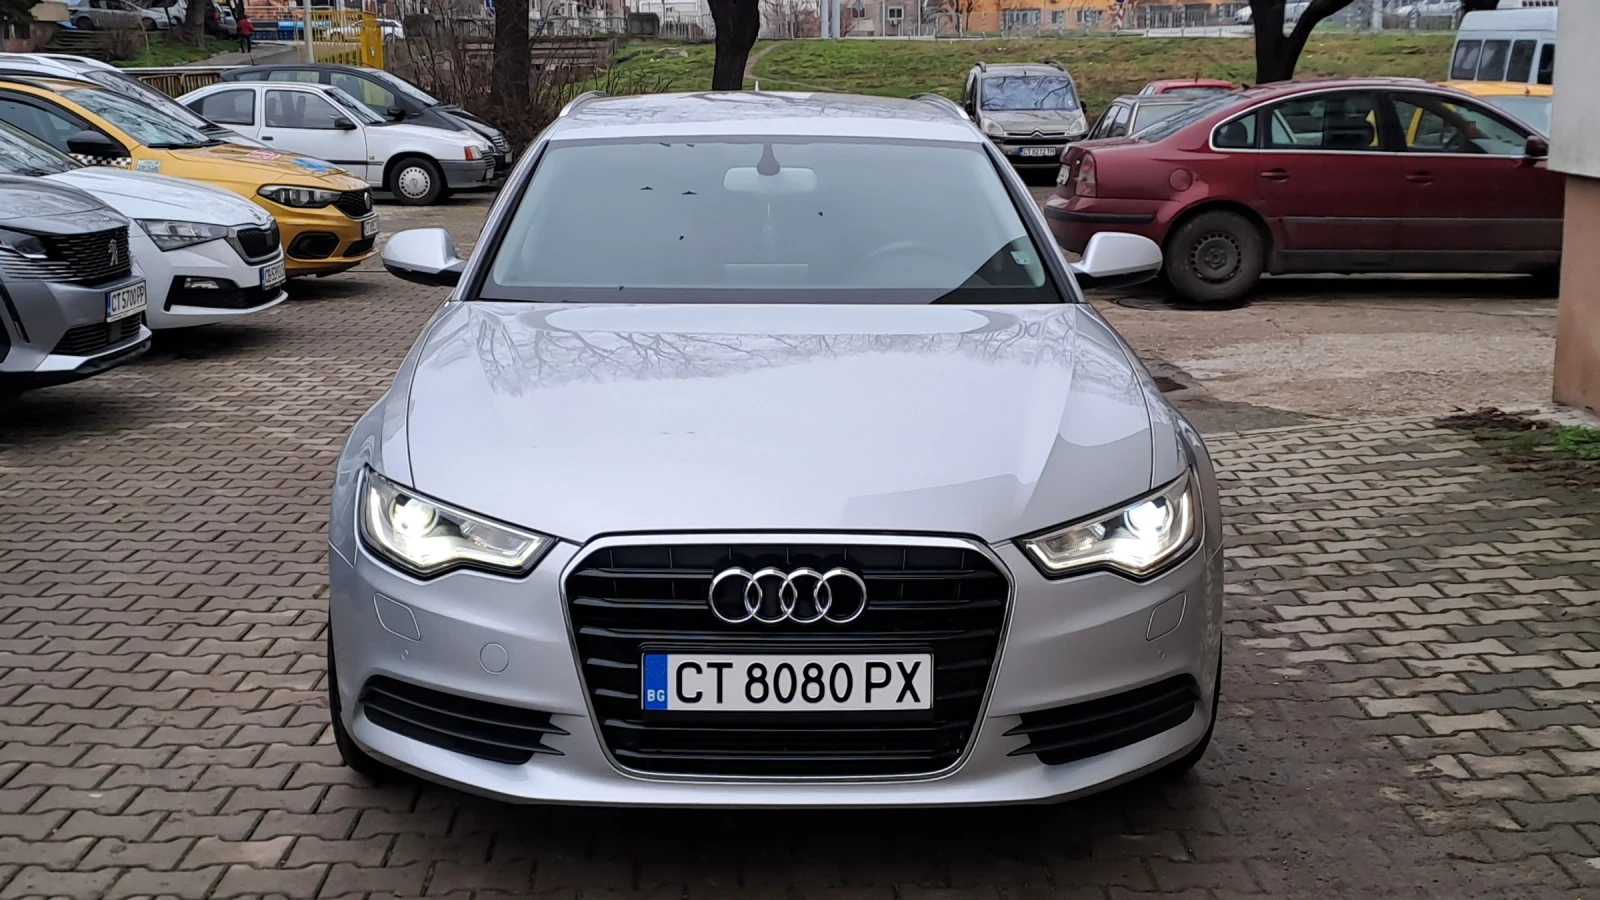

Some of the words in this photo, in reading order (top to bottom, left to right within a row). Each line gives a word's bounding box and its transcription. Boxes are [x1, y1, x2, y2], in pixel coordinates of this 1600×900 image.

[112, 292, 121, 312] CT
[137, 285, 145, 304] PP
[647, 689, 665, 702] BG
[675, 661, 733, 704] CT
[745, 662, 853, 704] 8080
[865, 660, 922, 703] PX
